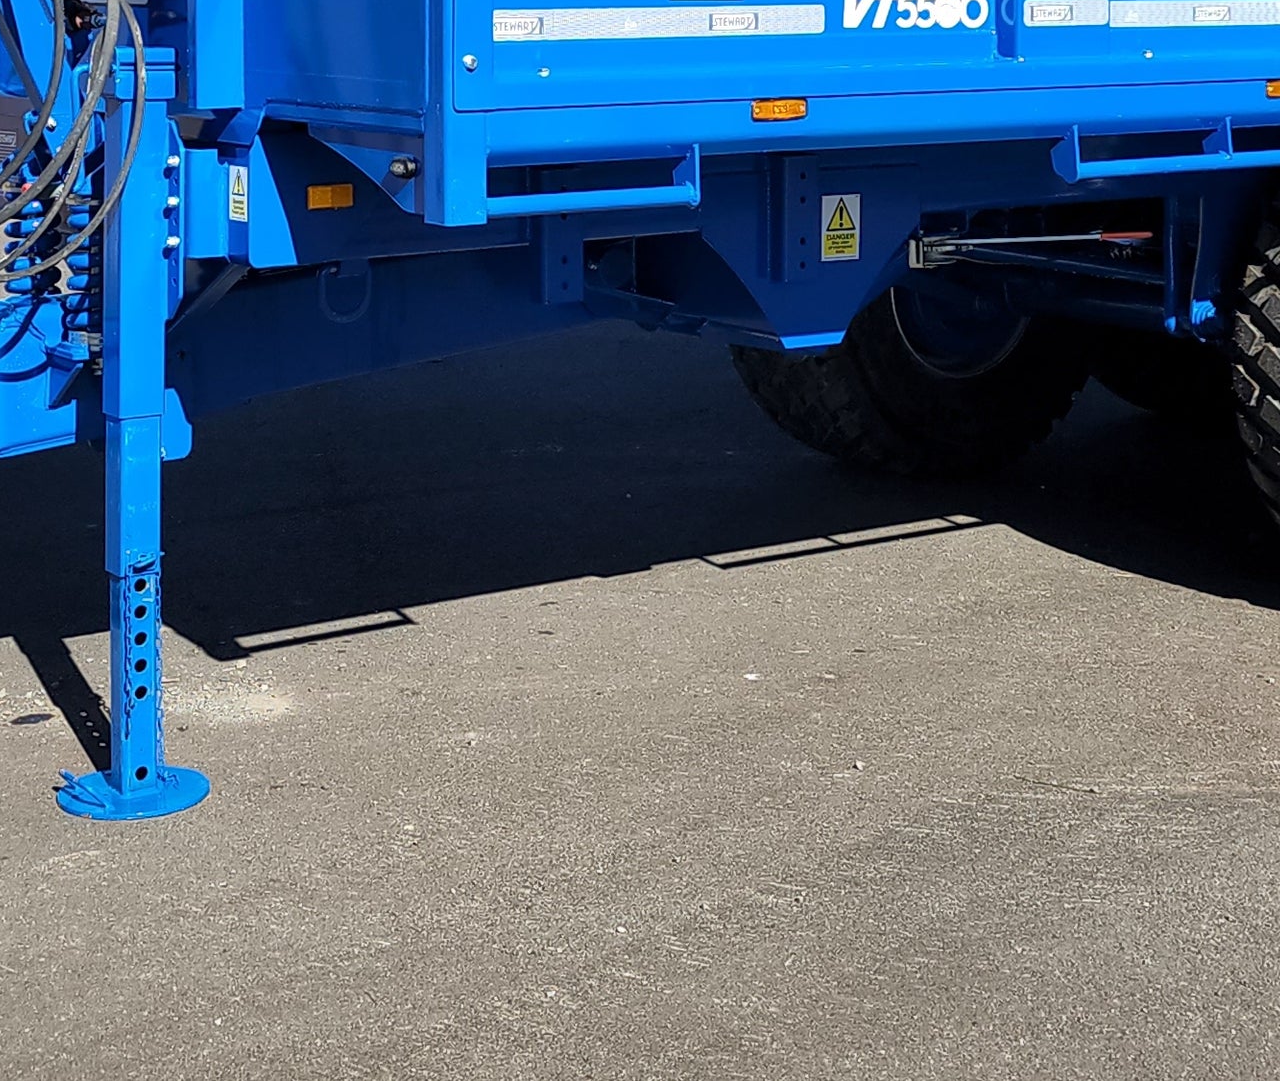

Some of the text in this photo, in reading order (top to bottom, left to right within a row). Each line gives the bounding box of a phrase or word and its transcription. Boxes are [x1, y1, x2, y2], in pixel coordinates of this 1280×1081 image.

[493, 20, 538, 34] STEWART
[713, 16, 754, 29] STEWART
[826, 232, 856, 241] DANGER
